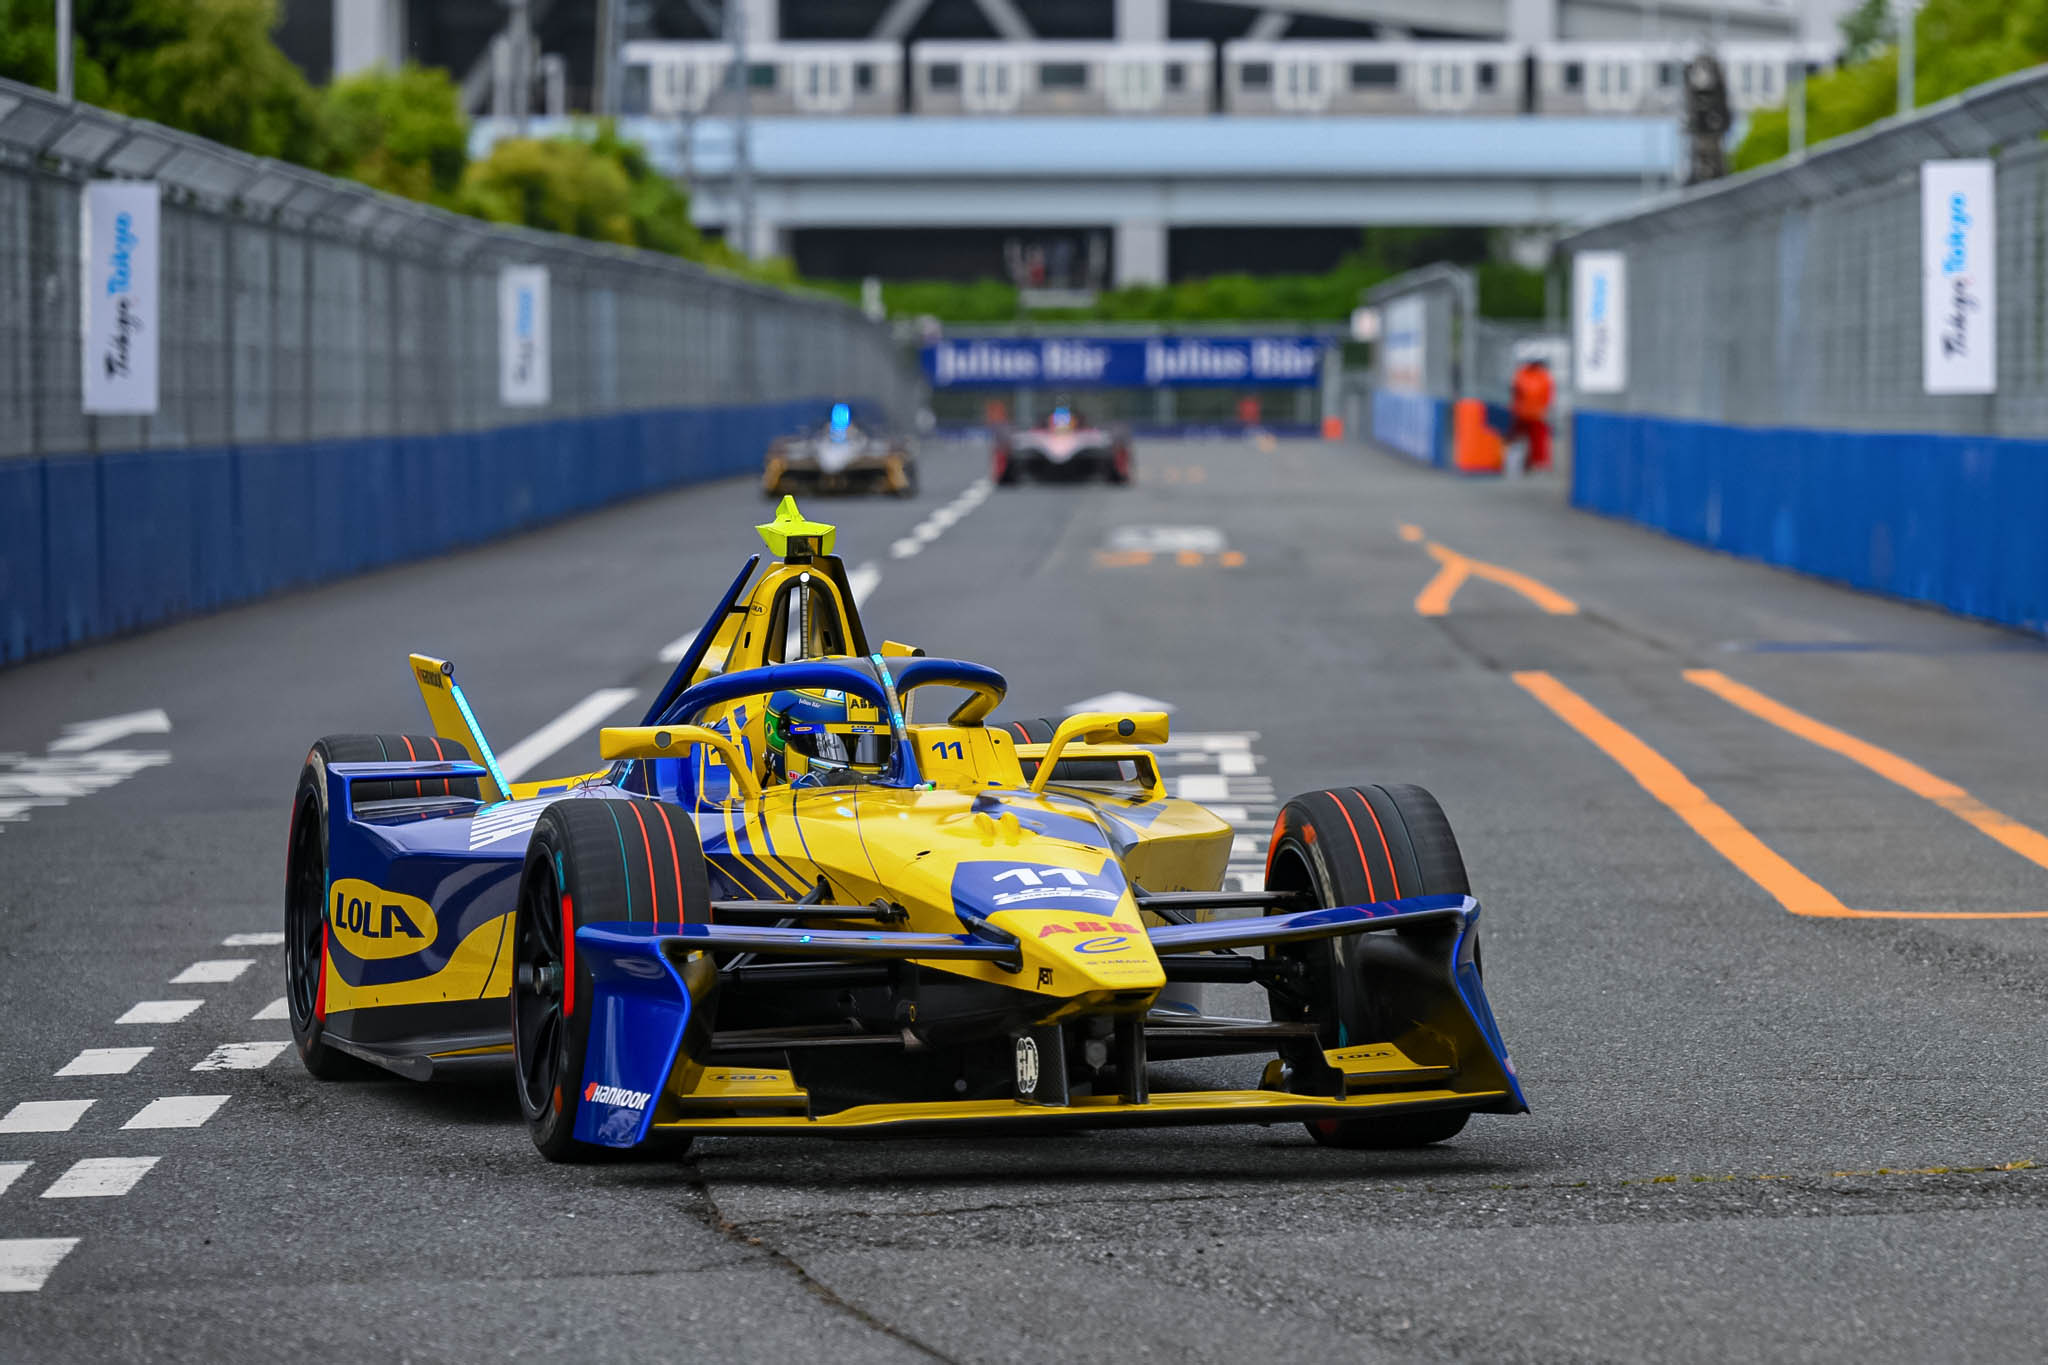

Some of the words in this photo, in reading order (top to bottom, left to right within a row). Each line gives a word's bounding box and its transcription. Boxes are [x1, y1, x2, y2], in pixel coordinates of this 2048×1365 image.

[932, 741, 964, 760] 11
[992, 868, 1089, 886] 11
[335, 891, 426, 939] LOLA
[1038, 921, 1143, 938] ABB
[1036, 967, 1054, 990] ABT
